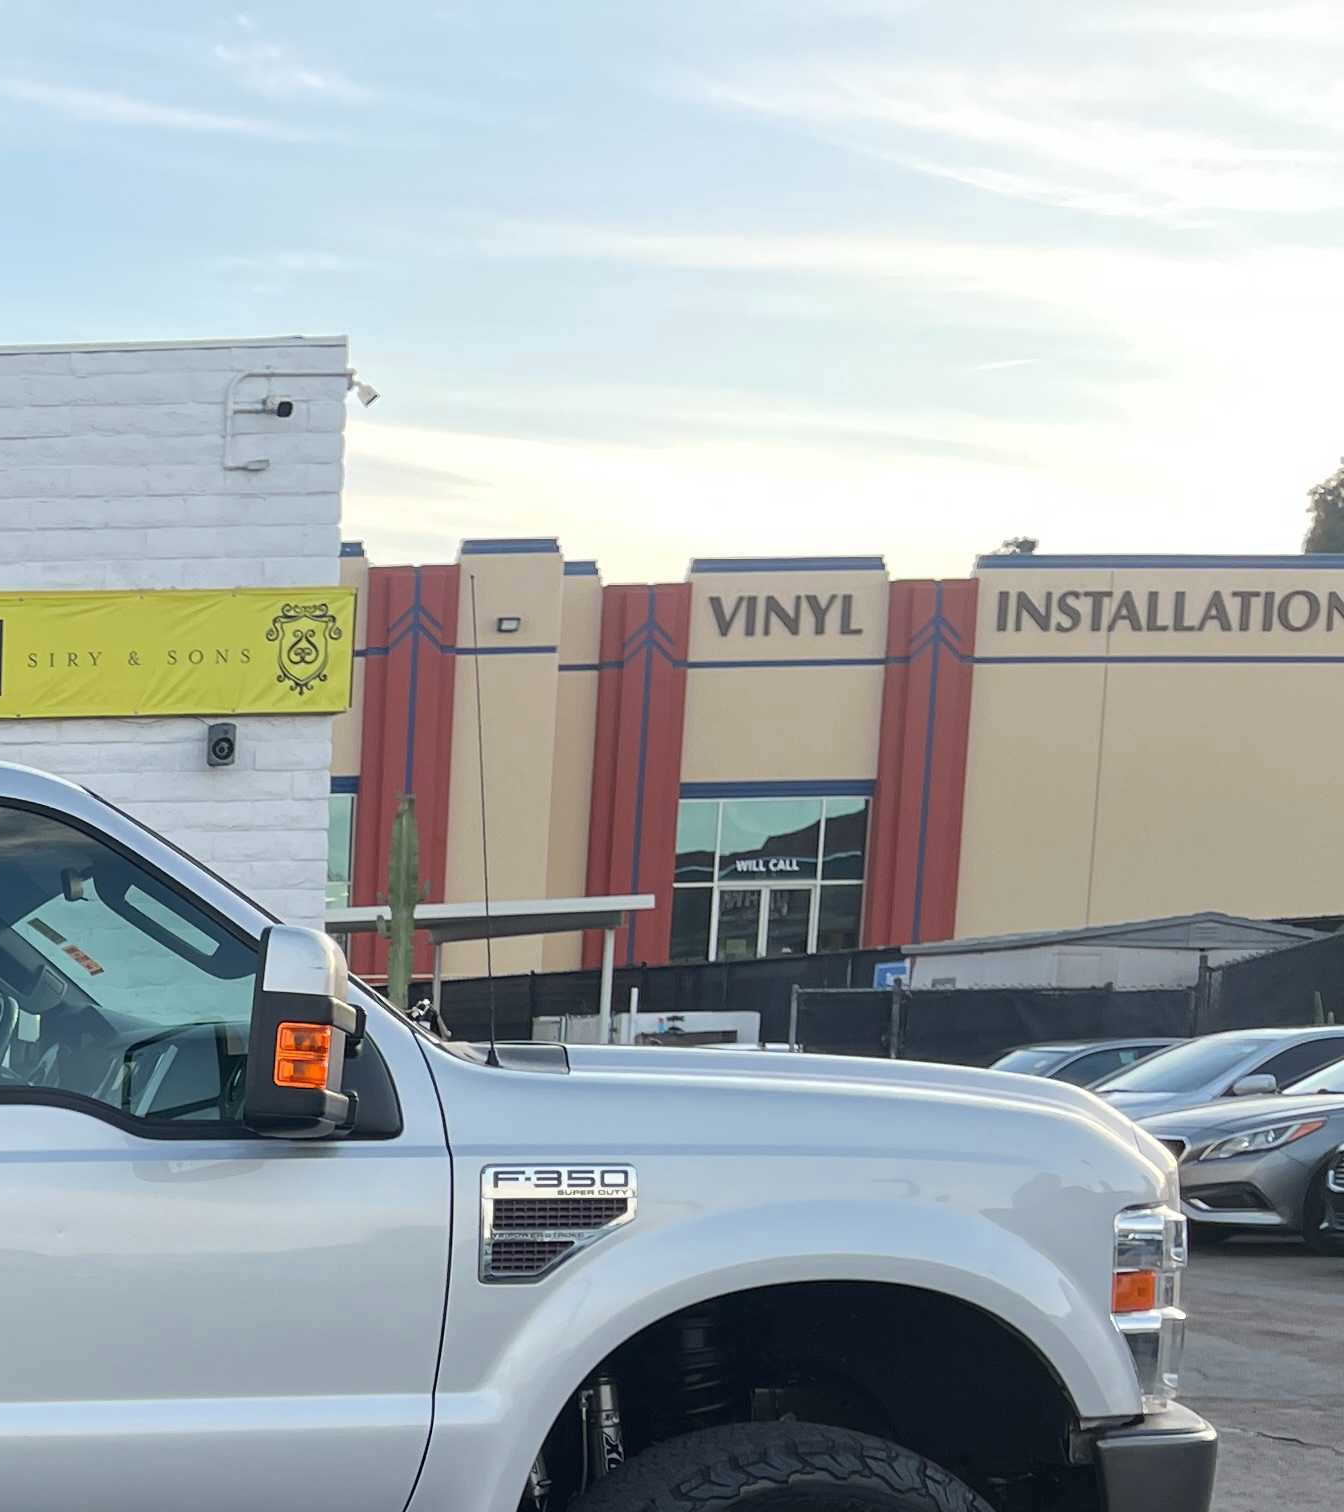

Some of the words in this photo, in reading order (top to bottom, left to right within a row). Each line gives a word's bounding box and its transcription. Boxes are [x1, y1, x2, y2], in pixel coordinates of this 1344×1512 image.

[708, 594, 863, 637] VINYL
[27, 651, 102, 668] SIRY
[127, 651, 141, 666] &
[167, 648, 251, 665] SONS
[735, 859, 766, 872] WILL
[768, 858, 800, 871] CALL
[493, 1170, 629, 1188] F-350
